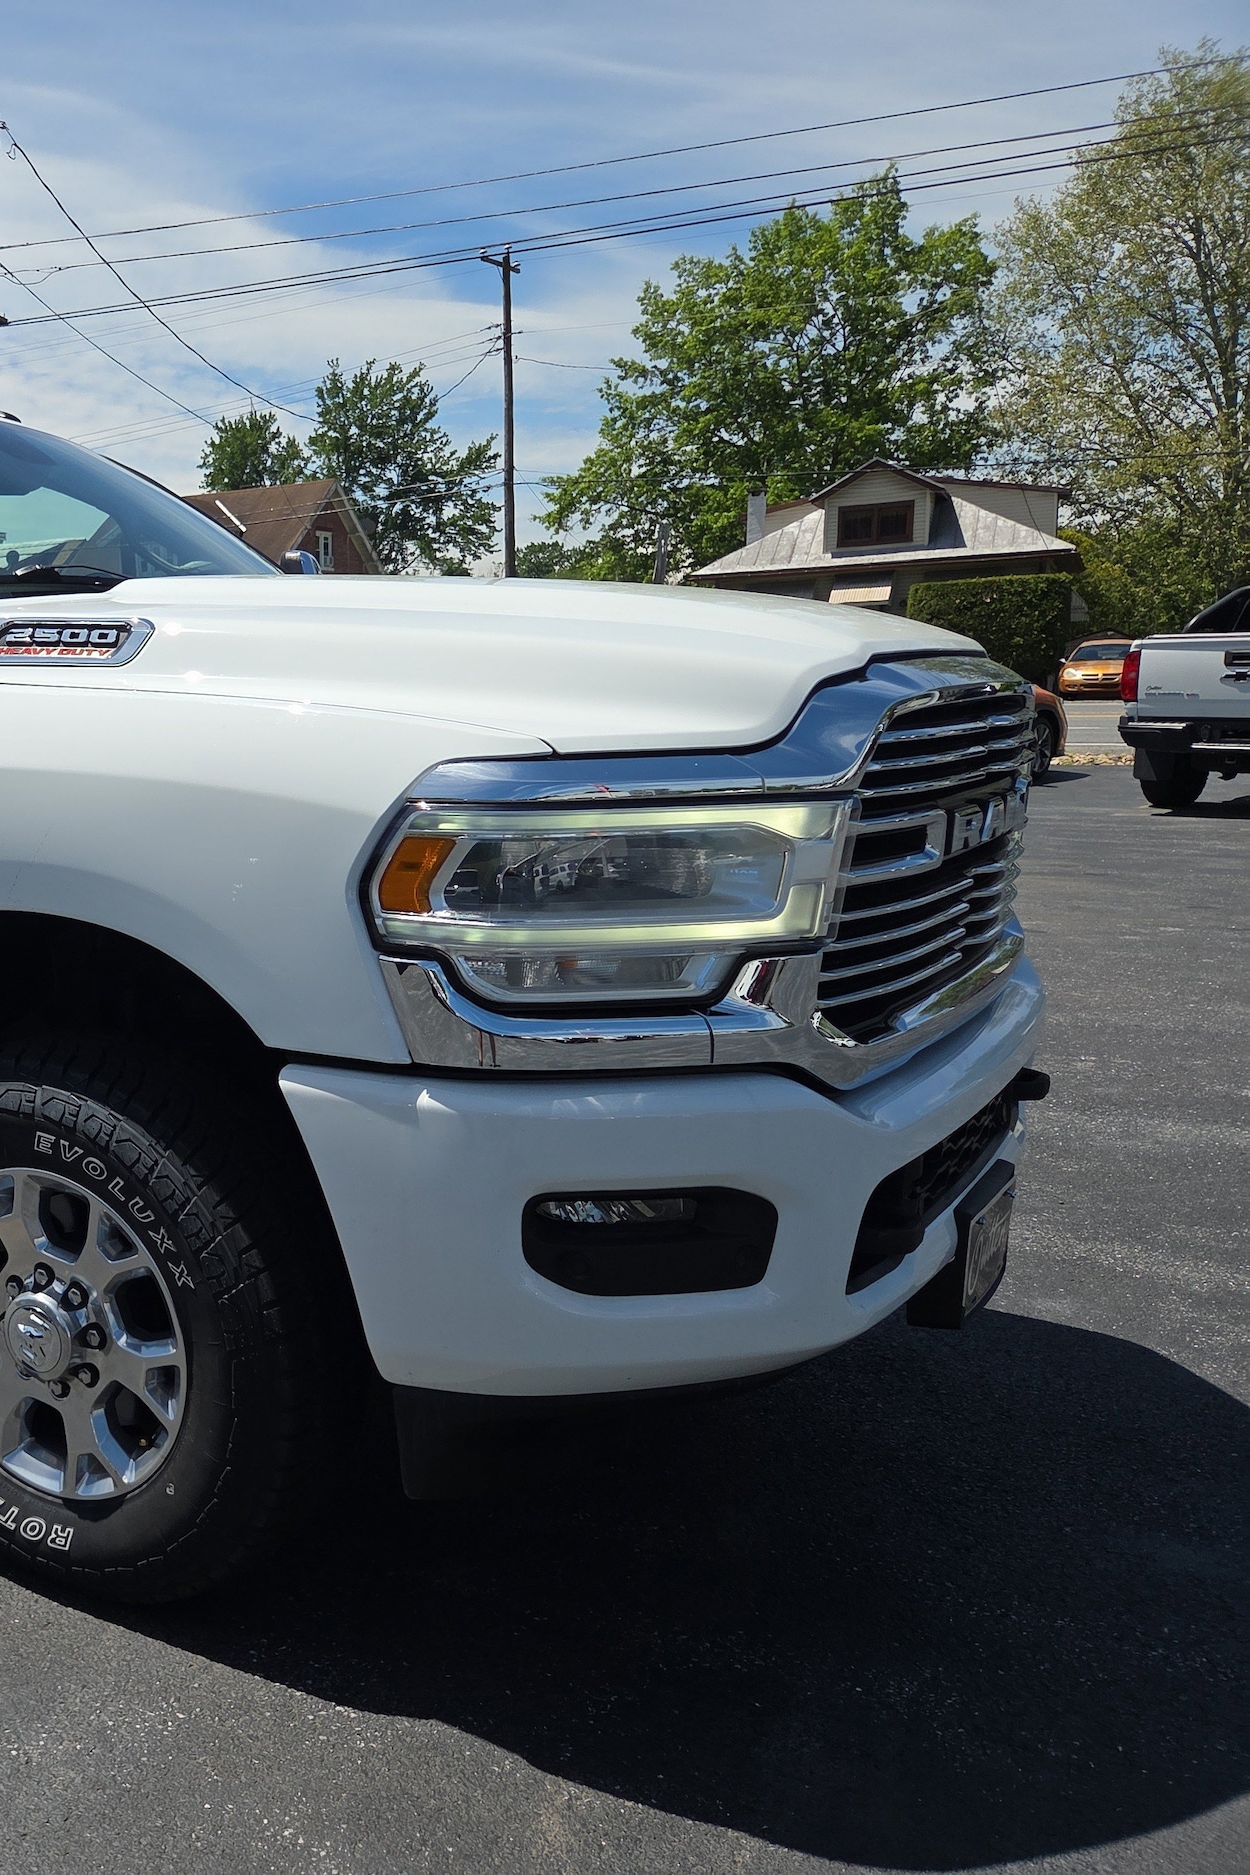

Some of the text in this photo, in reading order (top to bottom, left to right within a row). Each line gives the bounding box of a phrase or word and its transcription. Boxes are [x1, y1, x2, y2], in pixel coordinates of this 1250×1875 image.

[5, 627, 118, 646] 2500
[57, 648, 112, 657] DUTY
[34, 1131, 195, 1289] EVOLUXX
